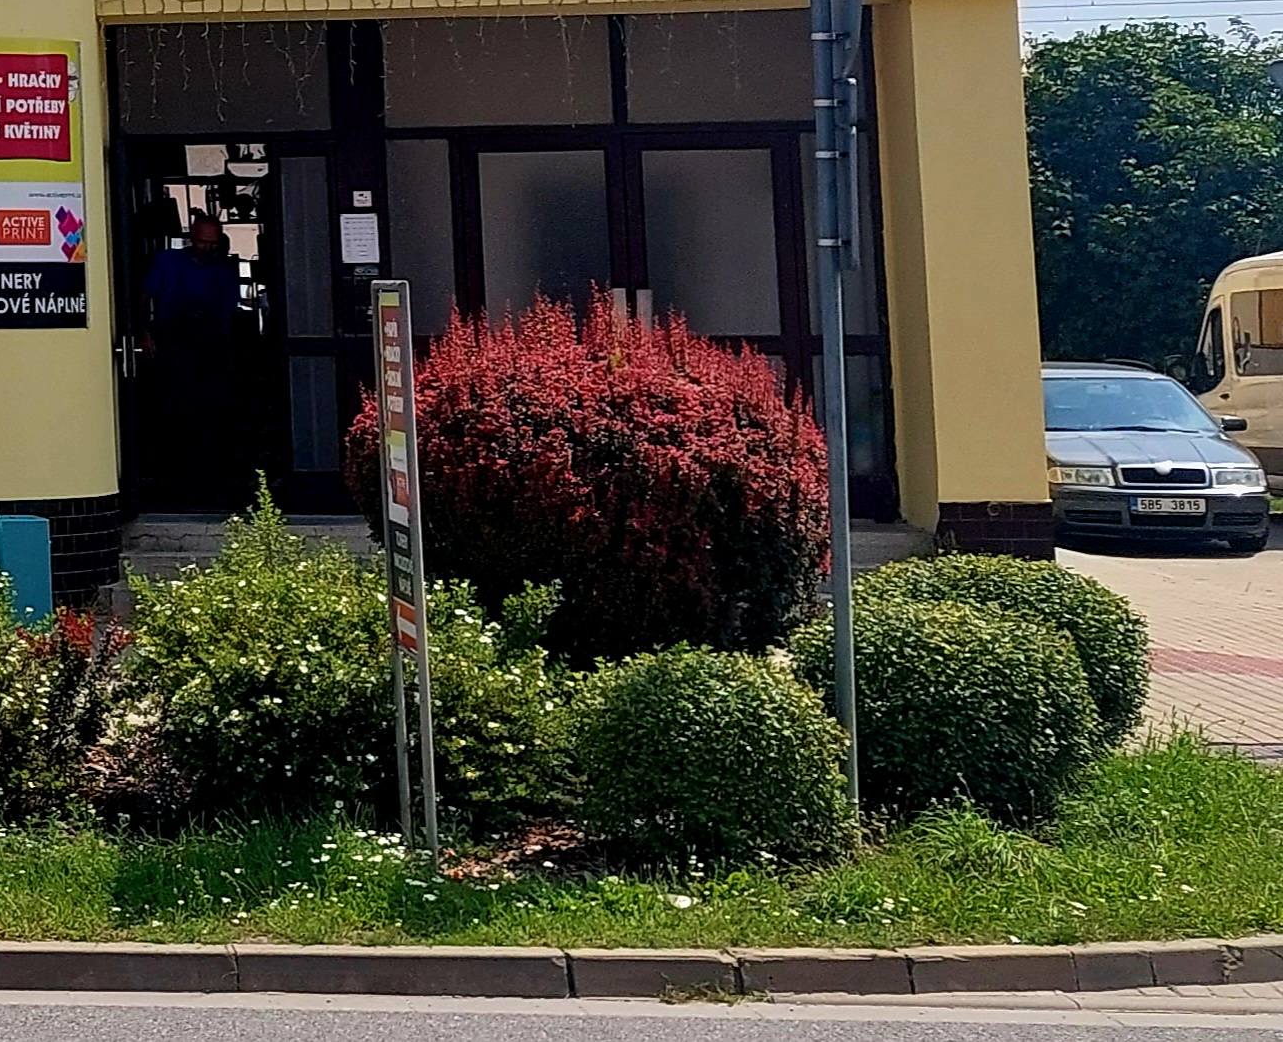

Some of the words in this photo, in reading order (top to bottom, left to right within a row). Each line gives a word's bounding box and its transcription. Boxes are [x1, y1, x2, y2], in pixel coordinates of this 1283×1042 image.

[7, 70, 62, 89] HRAČKY
[5, 96, 66, 115] POTŘEBY
[3, 122, 62, 140] KVĚTINY
[1, 216, 45, 228] ACTIVE
[1, 228, 45, 240] PRINT
[34, 292, 86, 314] NÁPLNĚ
[1140, 499, 1163, 510] 5B5
[1171, 500, 1200, 511] 3815
